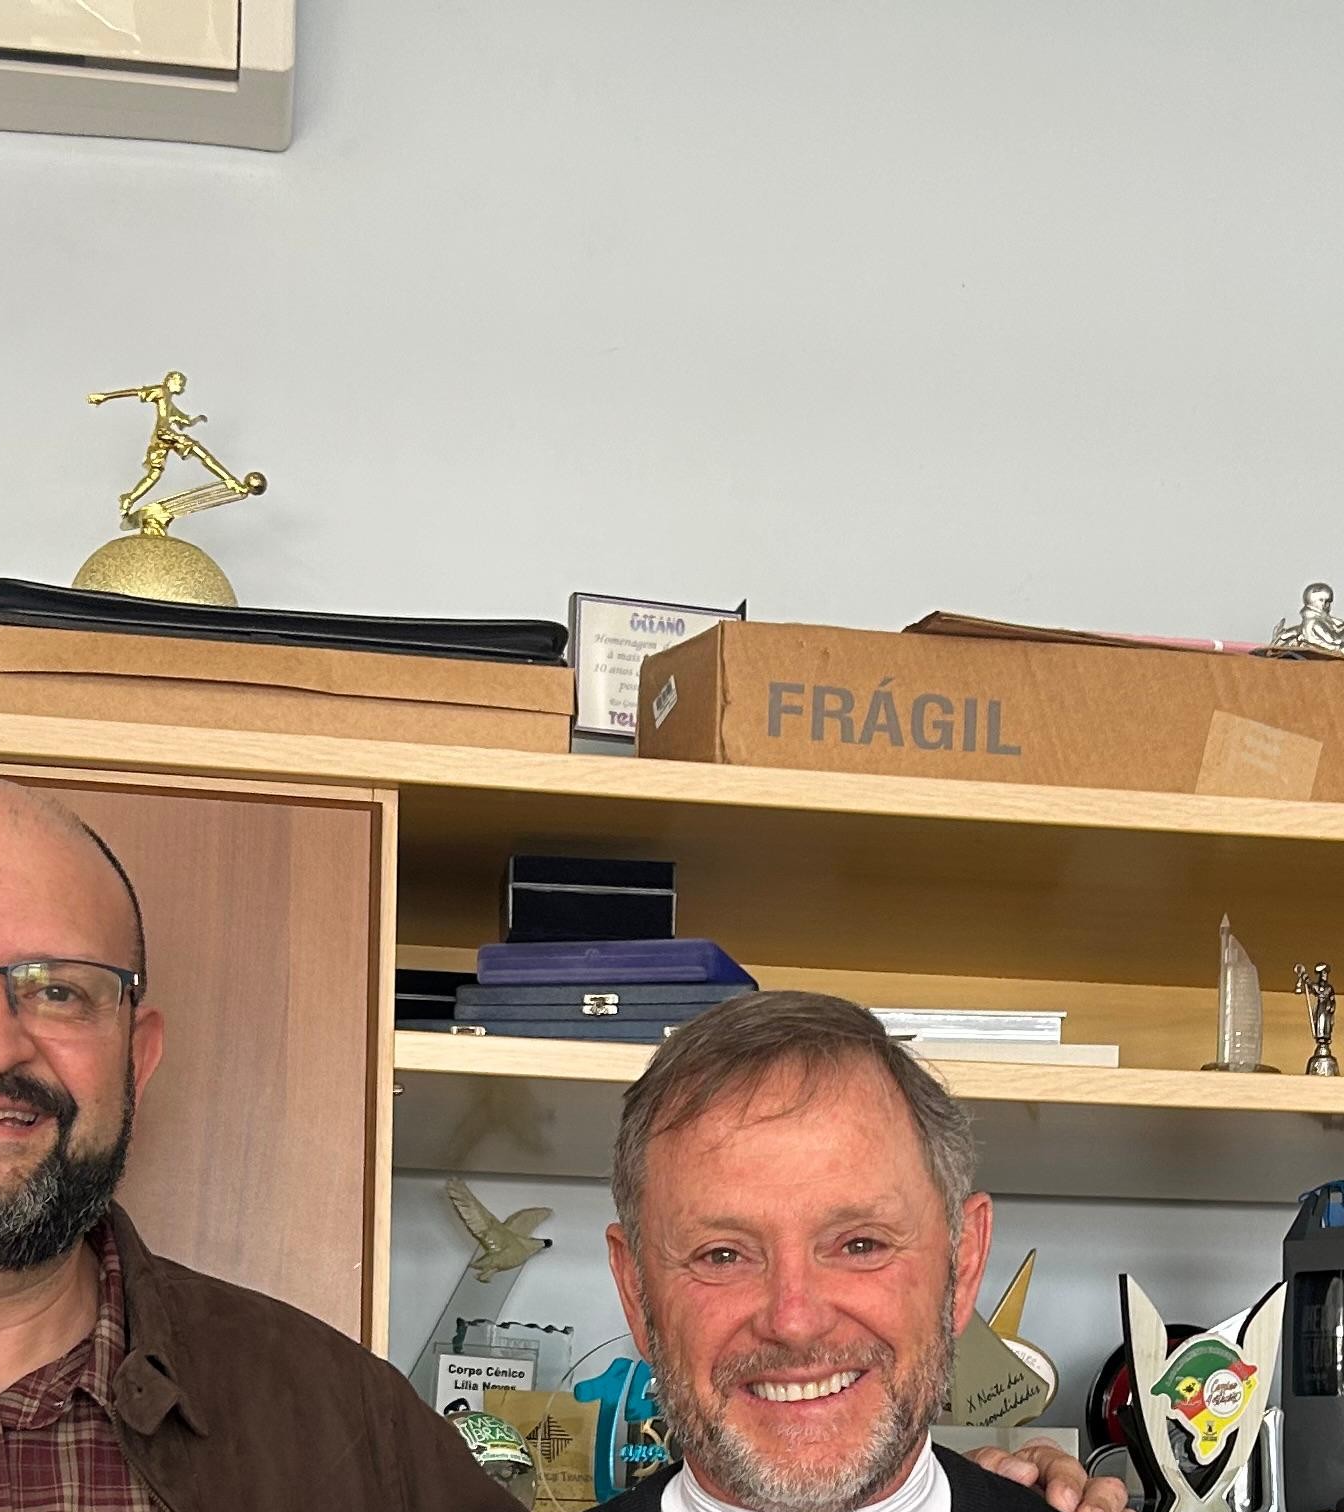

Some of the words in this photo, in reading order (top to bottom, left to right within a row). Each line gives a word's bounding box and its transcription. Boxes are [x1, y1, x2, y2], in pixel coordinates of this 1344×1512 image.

[768, 676, 1022, 756] FRÁGIL
[448, 1363, 483, 1377] Corpo
[977, 1383, 1004, 1408] Noite
[1007, 1372, 1024, 1390] das
